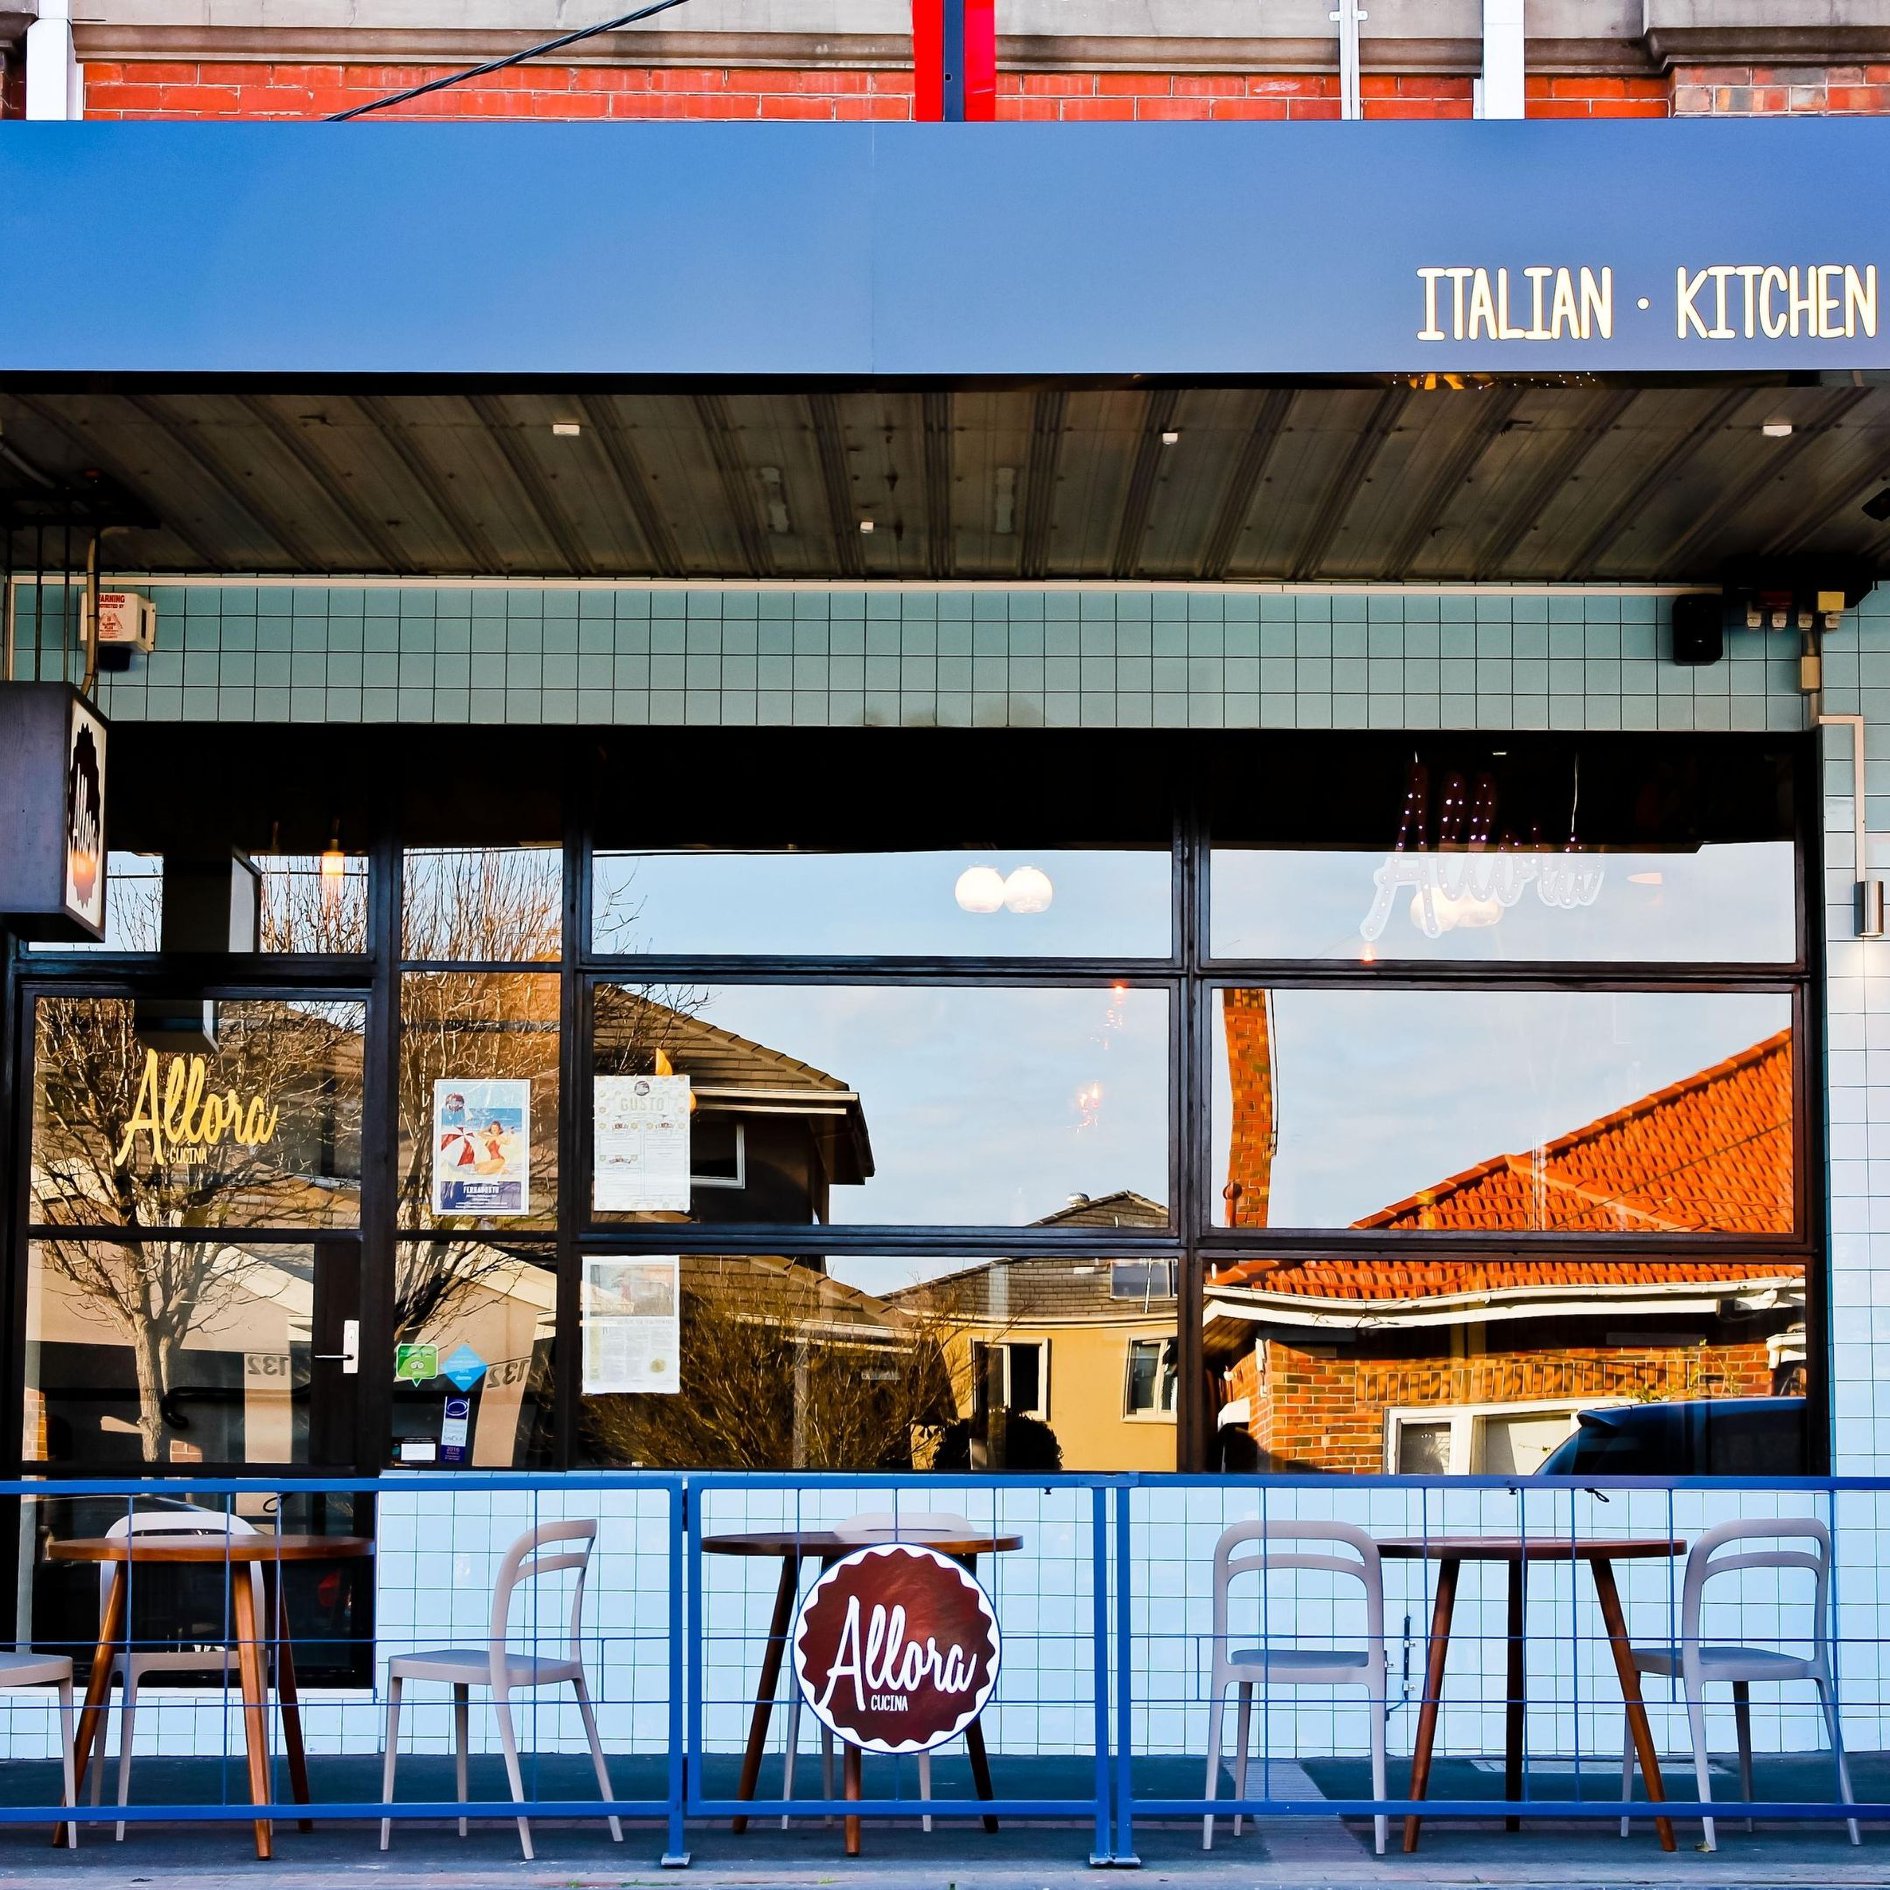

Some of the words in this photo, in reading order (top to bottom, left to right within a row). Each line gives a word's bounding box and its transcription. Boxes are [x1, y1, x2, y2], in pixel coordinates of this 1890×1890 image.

[1416, 266, 1612, 341] ITALIAN
[1676, 264, 1877, 340] KITCHEN
[114, 1048, 279, 1167] Allora
[620, 1097, 665, 1111] GUSTO
[169, 1147, 208, 1165] CUCINA
[815, 1595, 978, 1711] Allora
[870, 1694, 909, 1711] CUCINA
